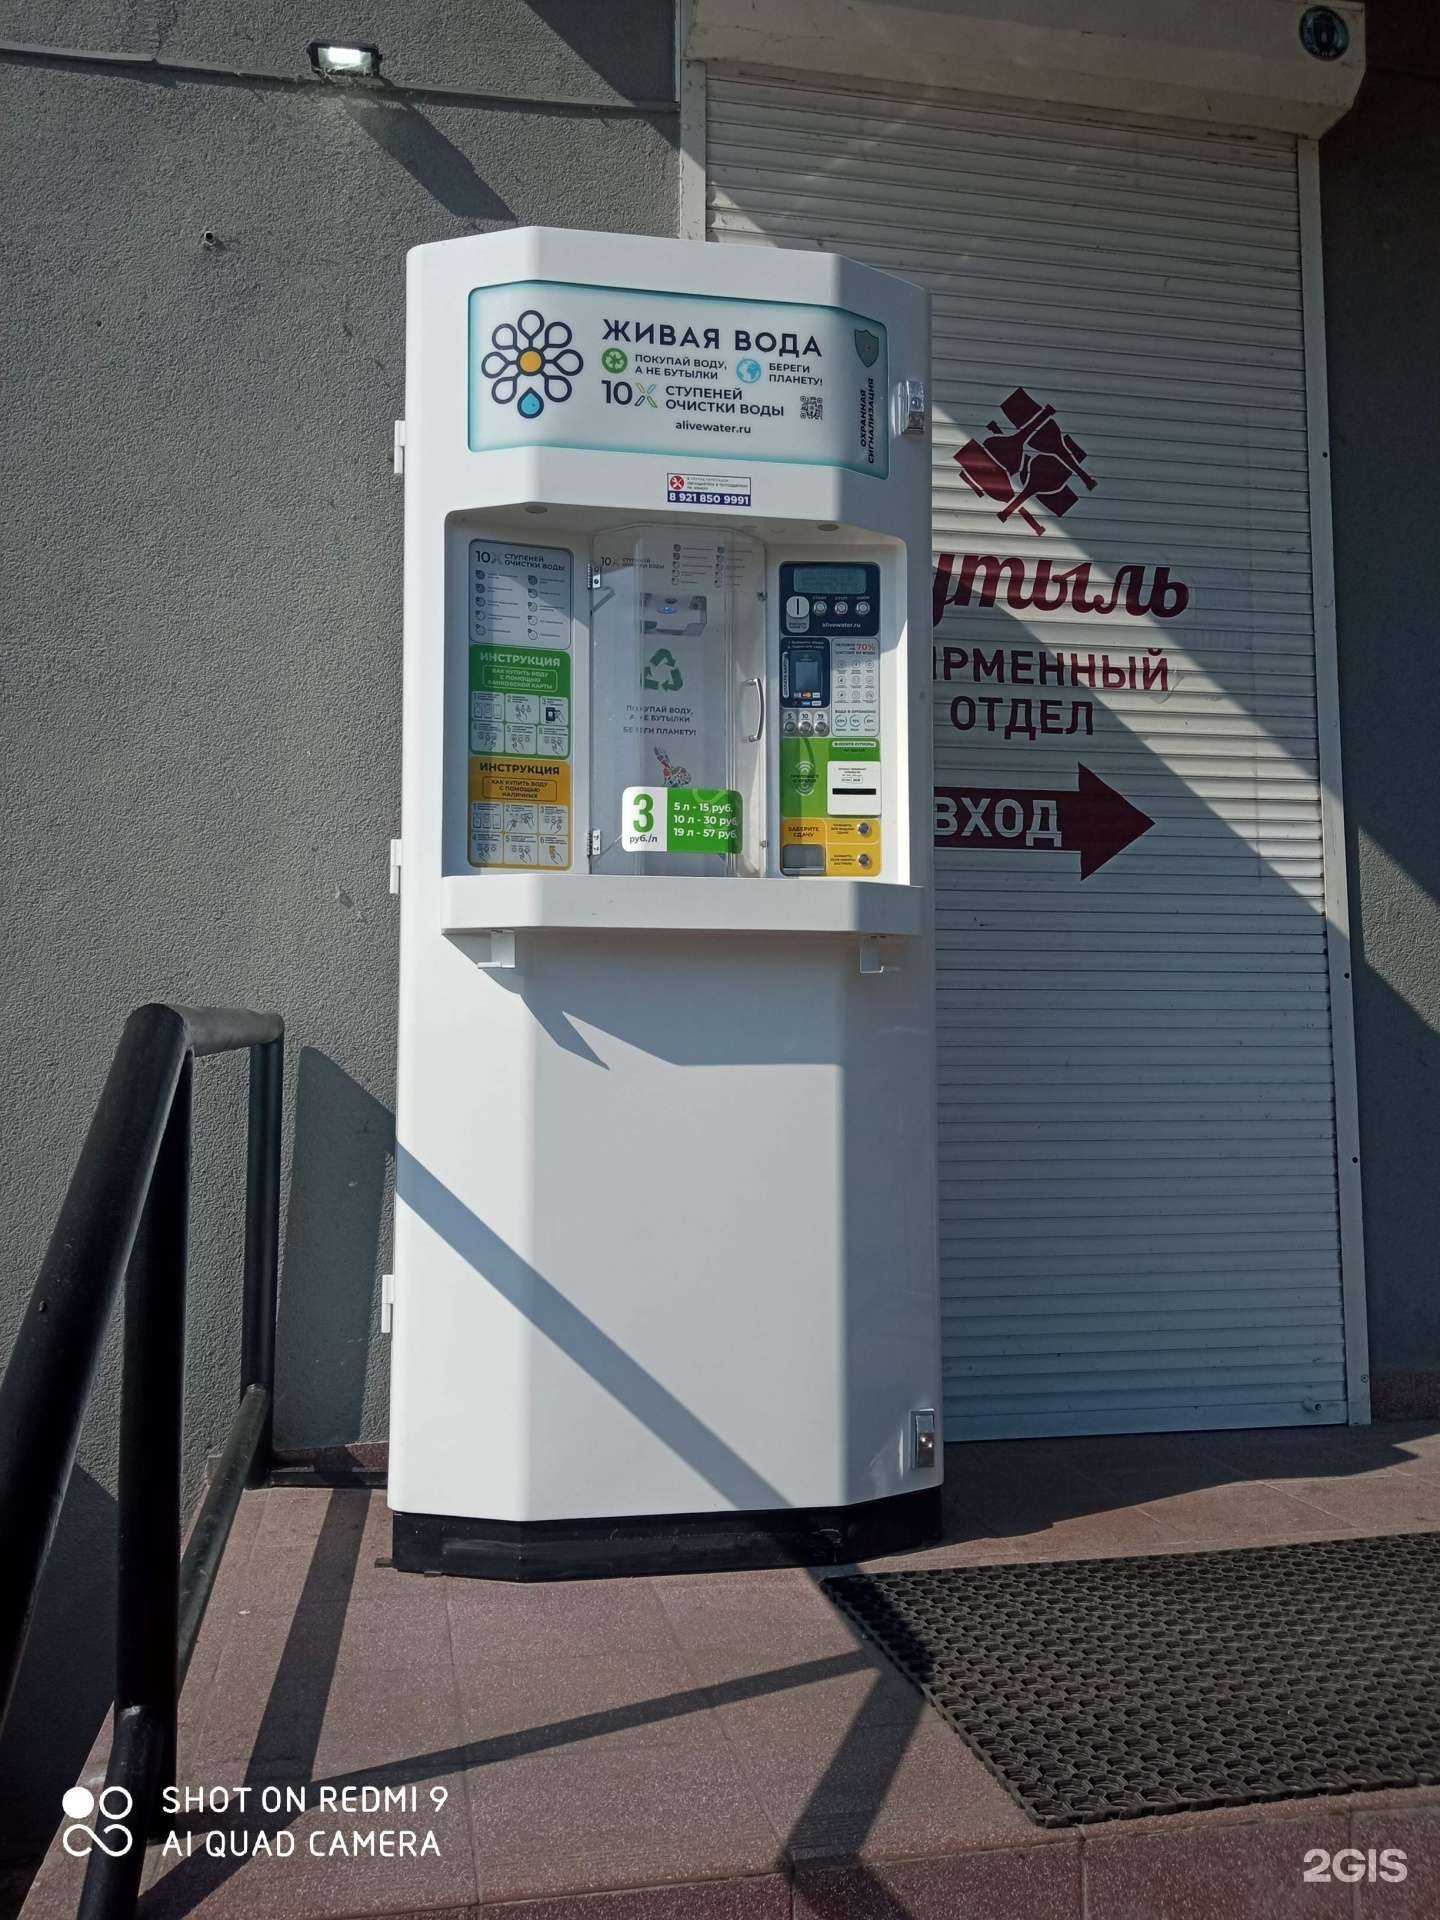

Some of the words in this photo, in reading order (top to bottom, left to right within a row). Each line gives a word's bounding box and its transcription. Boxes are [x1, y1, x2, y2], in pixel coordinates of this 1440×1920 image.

[602, 318, 720, 350] ЖИВАЯ
[734, 330, 823, 358] ВОДА
[635, 354, 690, 367] ПОКУПАЙ
[693, 358, 728, 370] ВОДУ,
[769, 362, 811, 374] БЕРЕГИ
[635, 366, 643, 375] А
[646, 367, 661, 376] НЕ
[664, 368, 719, 380] БУТЫЛКИ
[769, 374, 823, 387] ПЛАНЕТУ!
[665, 385, 743, 401] СТУПЕНЕЙ
[665, 399, 736, 414] ОЧИСТКИ
[740, 403, 785, 418] ВОДЫ
[675, 420, 751, 434] alivewater.ru
[867, 377, 875, 464] СИГНАЛИЗАЦИЯ
[669, 492, 676, 501] 8
[679, 493, 697, 503] 921
[700, 493, 721, 504] 850
[723, 495, 749, 505] 9991
[480, 652, 561, 667] ИНСТРУКЦИЯ
[950, 695, 1094, 741] ОТДЕЛ
[480, 762, 560, 776] ИНСТРУКЦИЯ
[633, 793, 654, 833] 3
[674, 802, 681, 811] 5
[700, 803, 710, 812] 15
[712, 803, 733, 813] руб.
[674, 815, 685, 824] 10
[704, 816, 717, 825] 30
[934, 796, 1062, 848] ВХОД
[629, 834, 658, 844] руб./л
[674, 828, 685, 837] 19
[704, 829, 715, 838] 57
